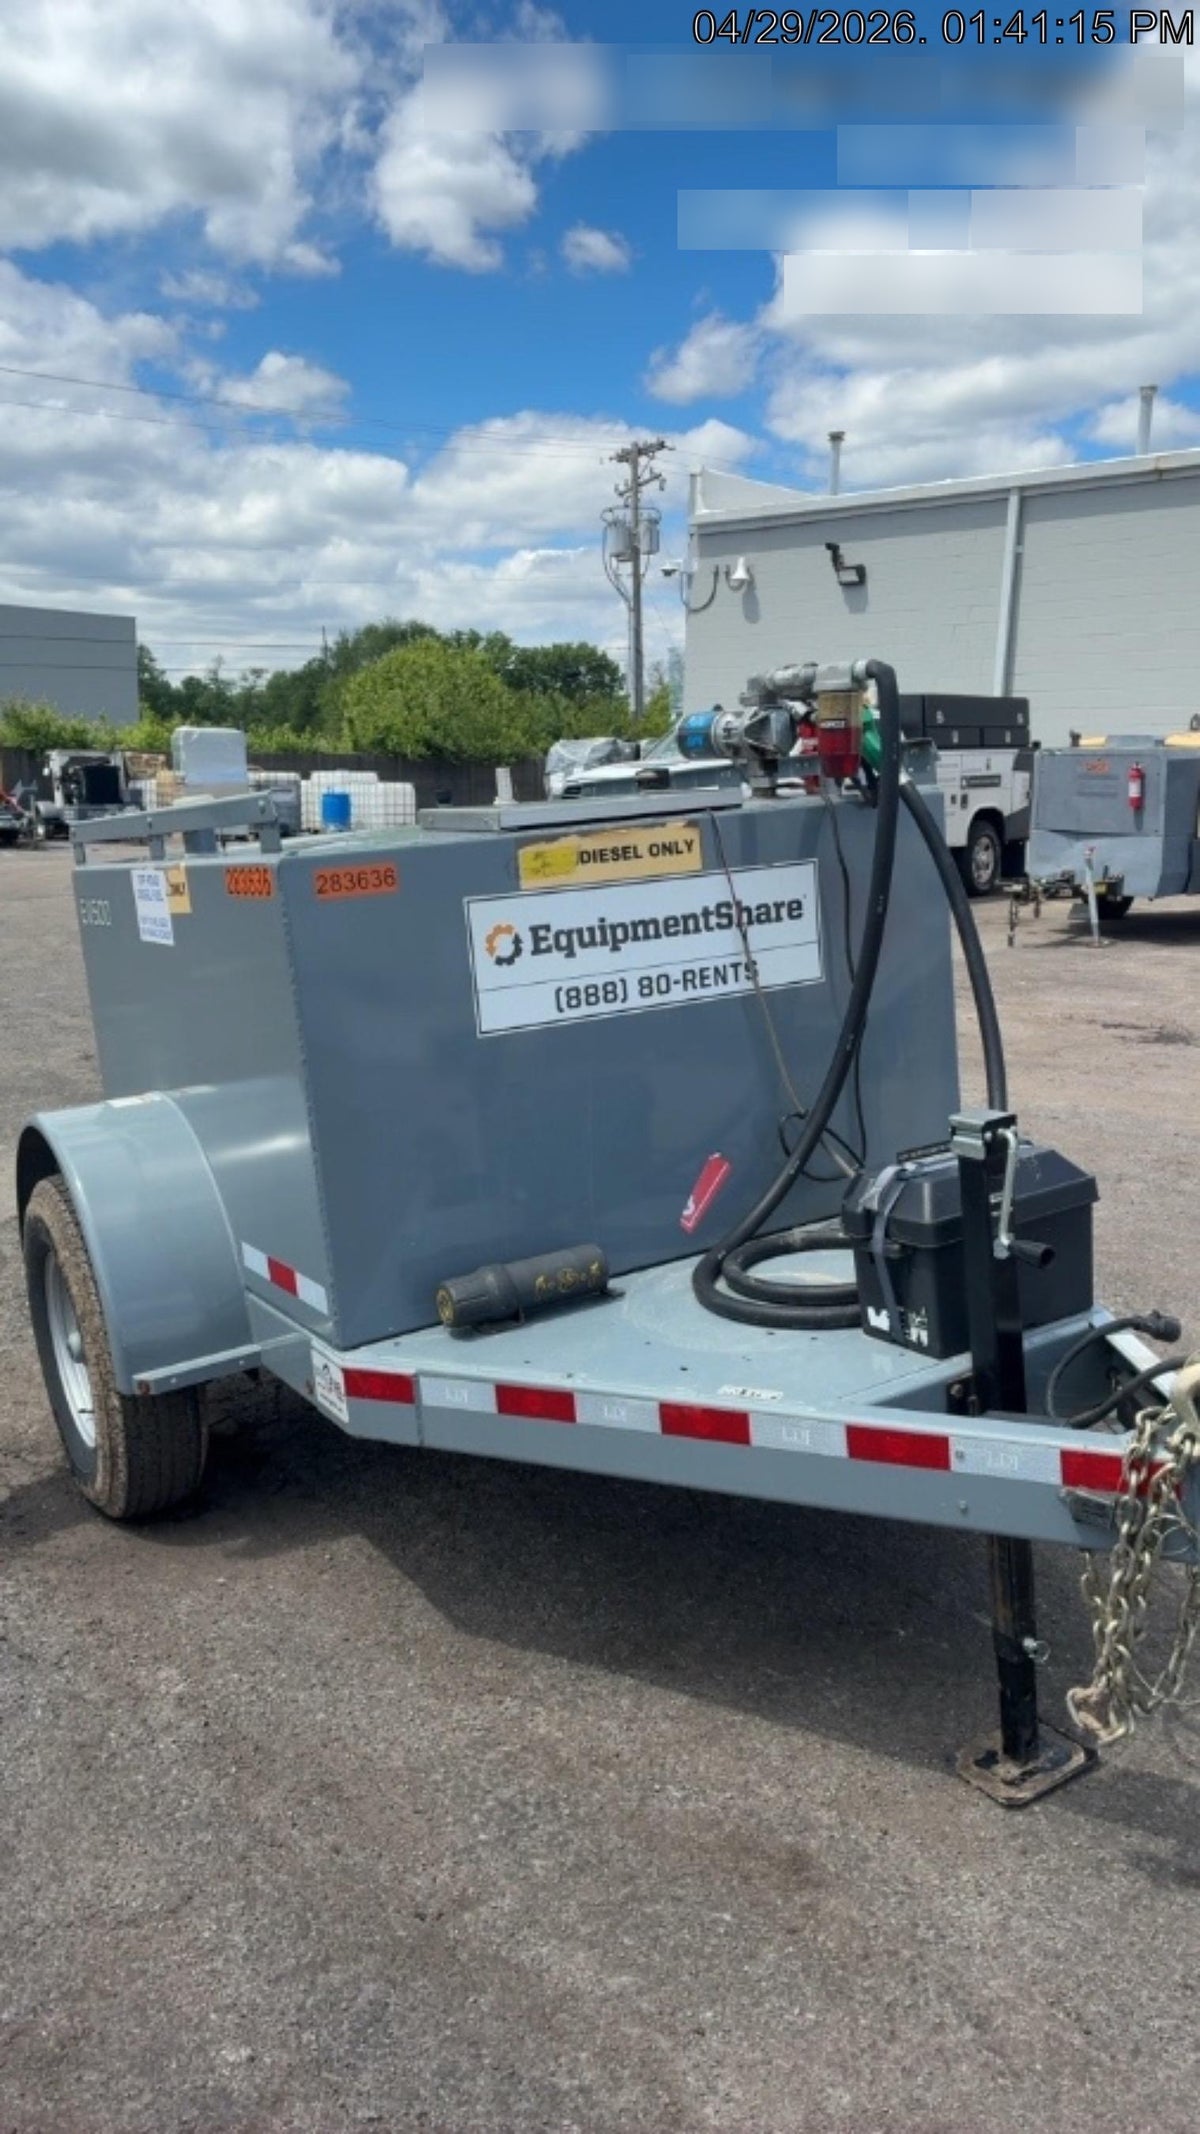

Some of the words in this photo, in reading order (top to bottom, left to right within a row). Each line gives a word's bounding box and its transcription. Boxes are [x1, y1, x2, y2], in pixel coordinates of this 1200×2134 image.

[580, 845, 644, 865] DIESEL
[649, 839, 695, 857] ONLY
[316, 867, 397, 895] 283636
[529, 897, 804, 959] EquipmentShare
[555, 976, 628, 1013] (888)
[637, 959, 759, 998] 80-RENTS
